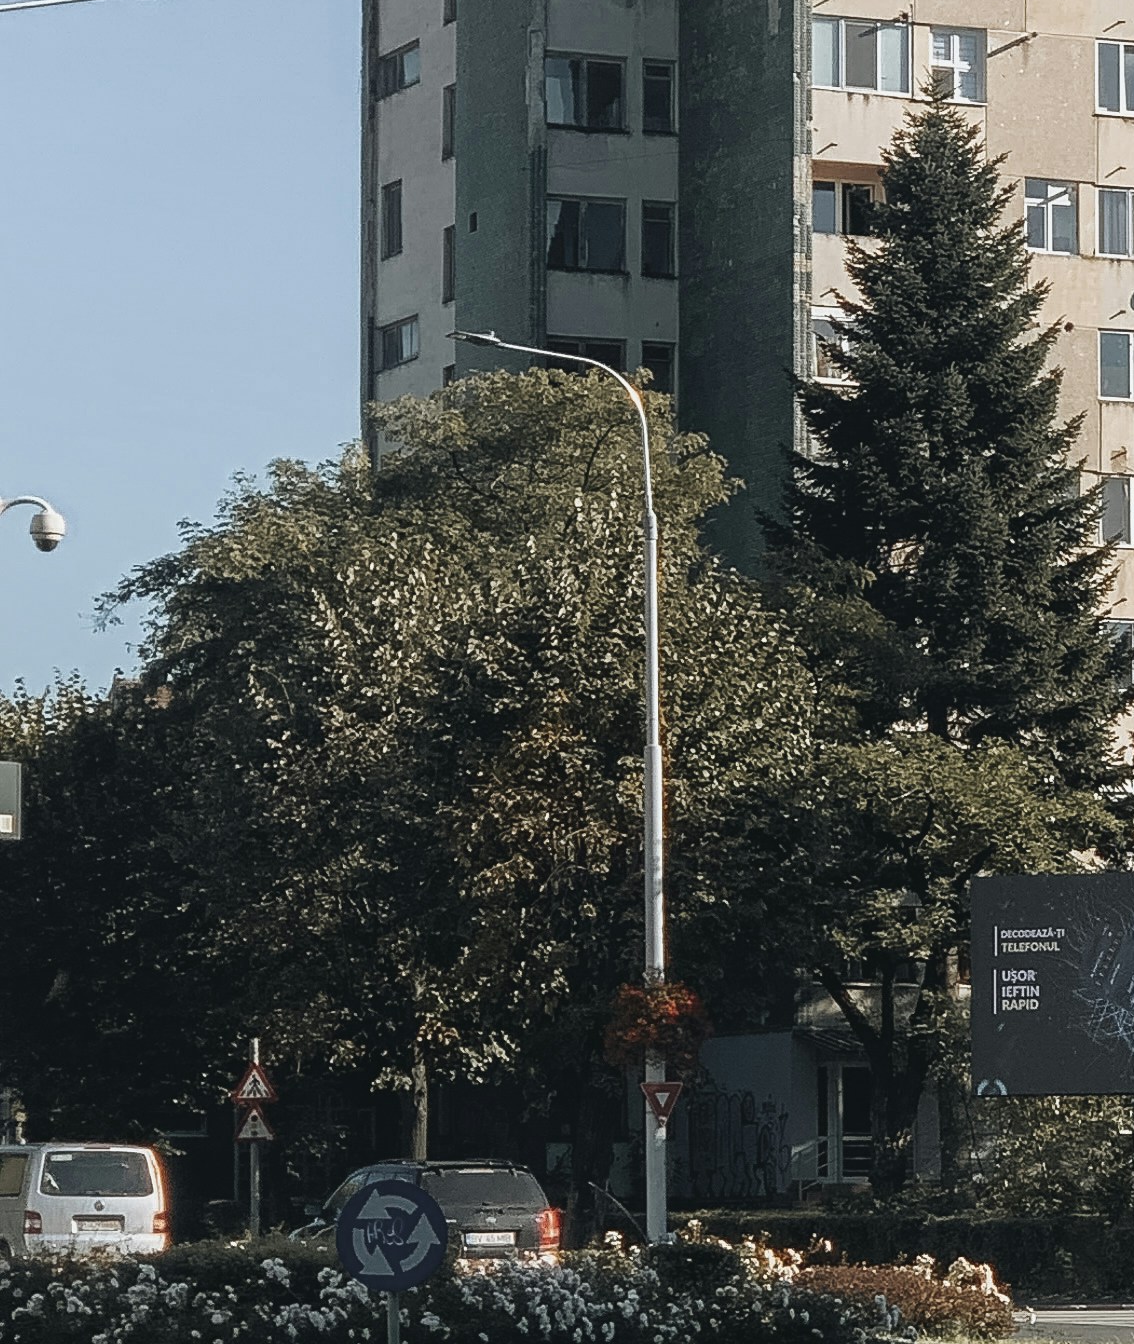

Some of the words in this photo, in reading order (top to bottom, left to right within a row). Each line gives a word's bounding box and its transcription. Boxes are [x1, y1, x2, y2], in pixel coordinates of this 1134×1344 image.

[1001, 941, 1060, 953] TELEFONUL
[1001, 969, 1036, 984] UȘOR
[1001, 985, 1040, 998] IEFTIN
[1001, 998, 1040, 1011] RAPID
